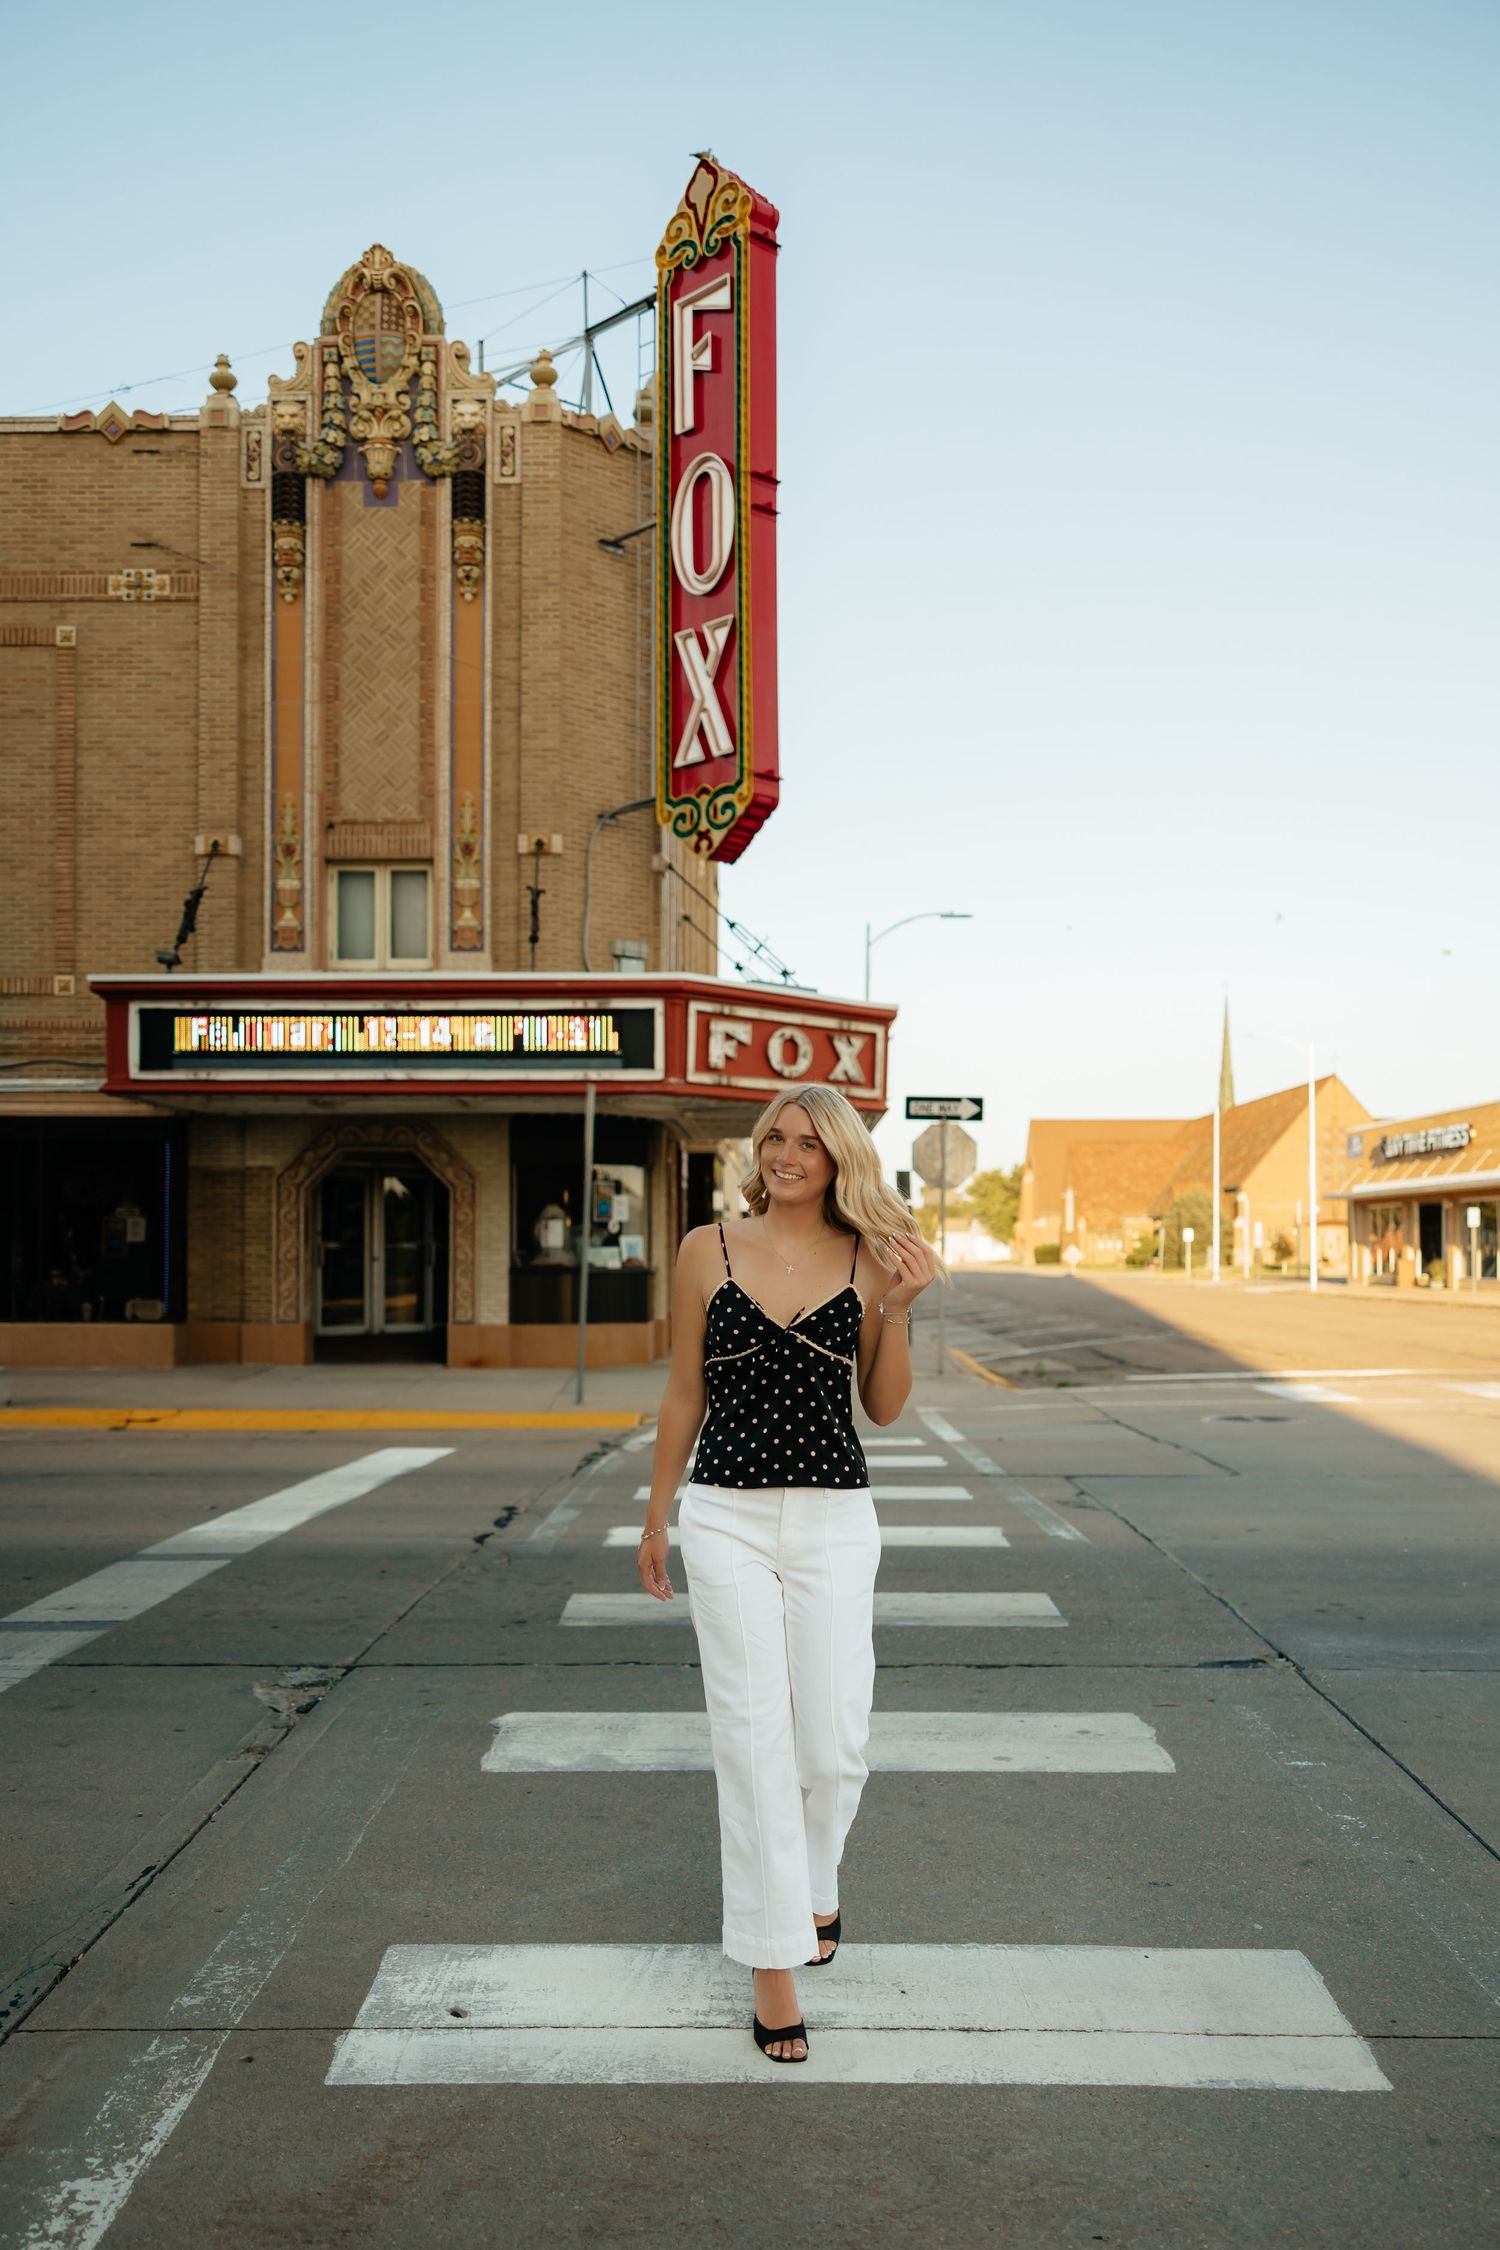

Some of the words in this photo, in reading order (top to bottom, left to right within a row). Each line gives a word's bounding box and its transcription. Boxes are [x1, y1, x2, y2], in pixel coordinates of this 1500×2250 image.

[671, 273, 736, 768] FOX
[708, 1018, 867, 1083] FOX
[914, 1103, 933, 1112] ONE
[938, 1103, 959, 1112] WAY
